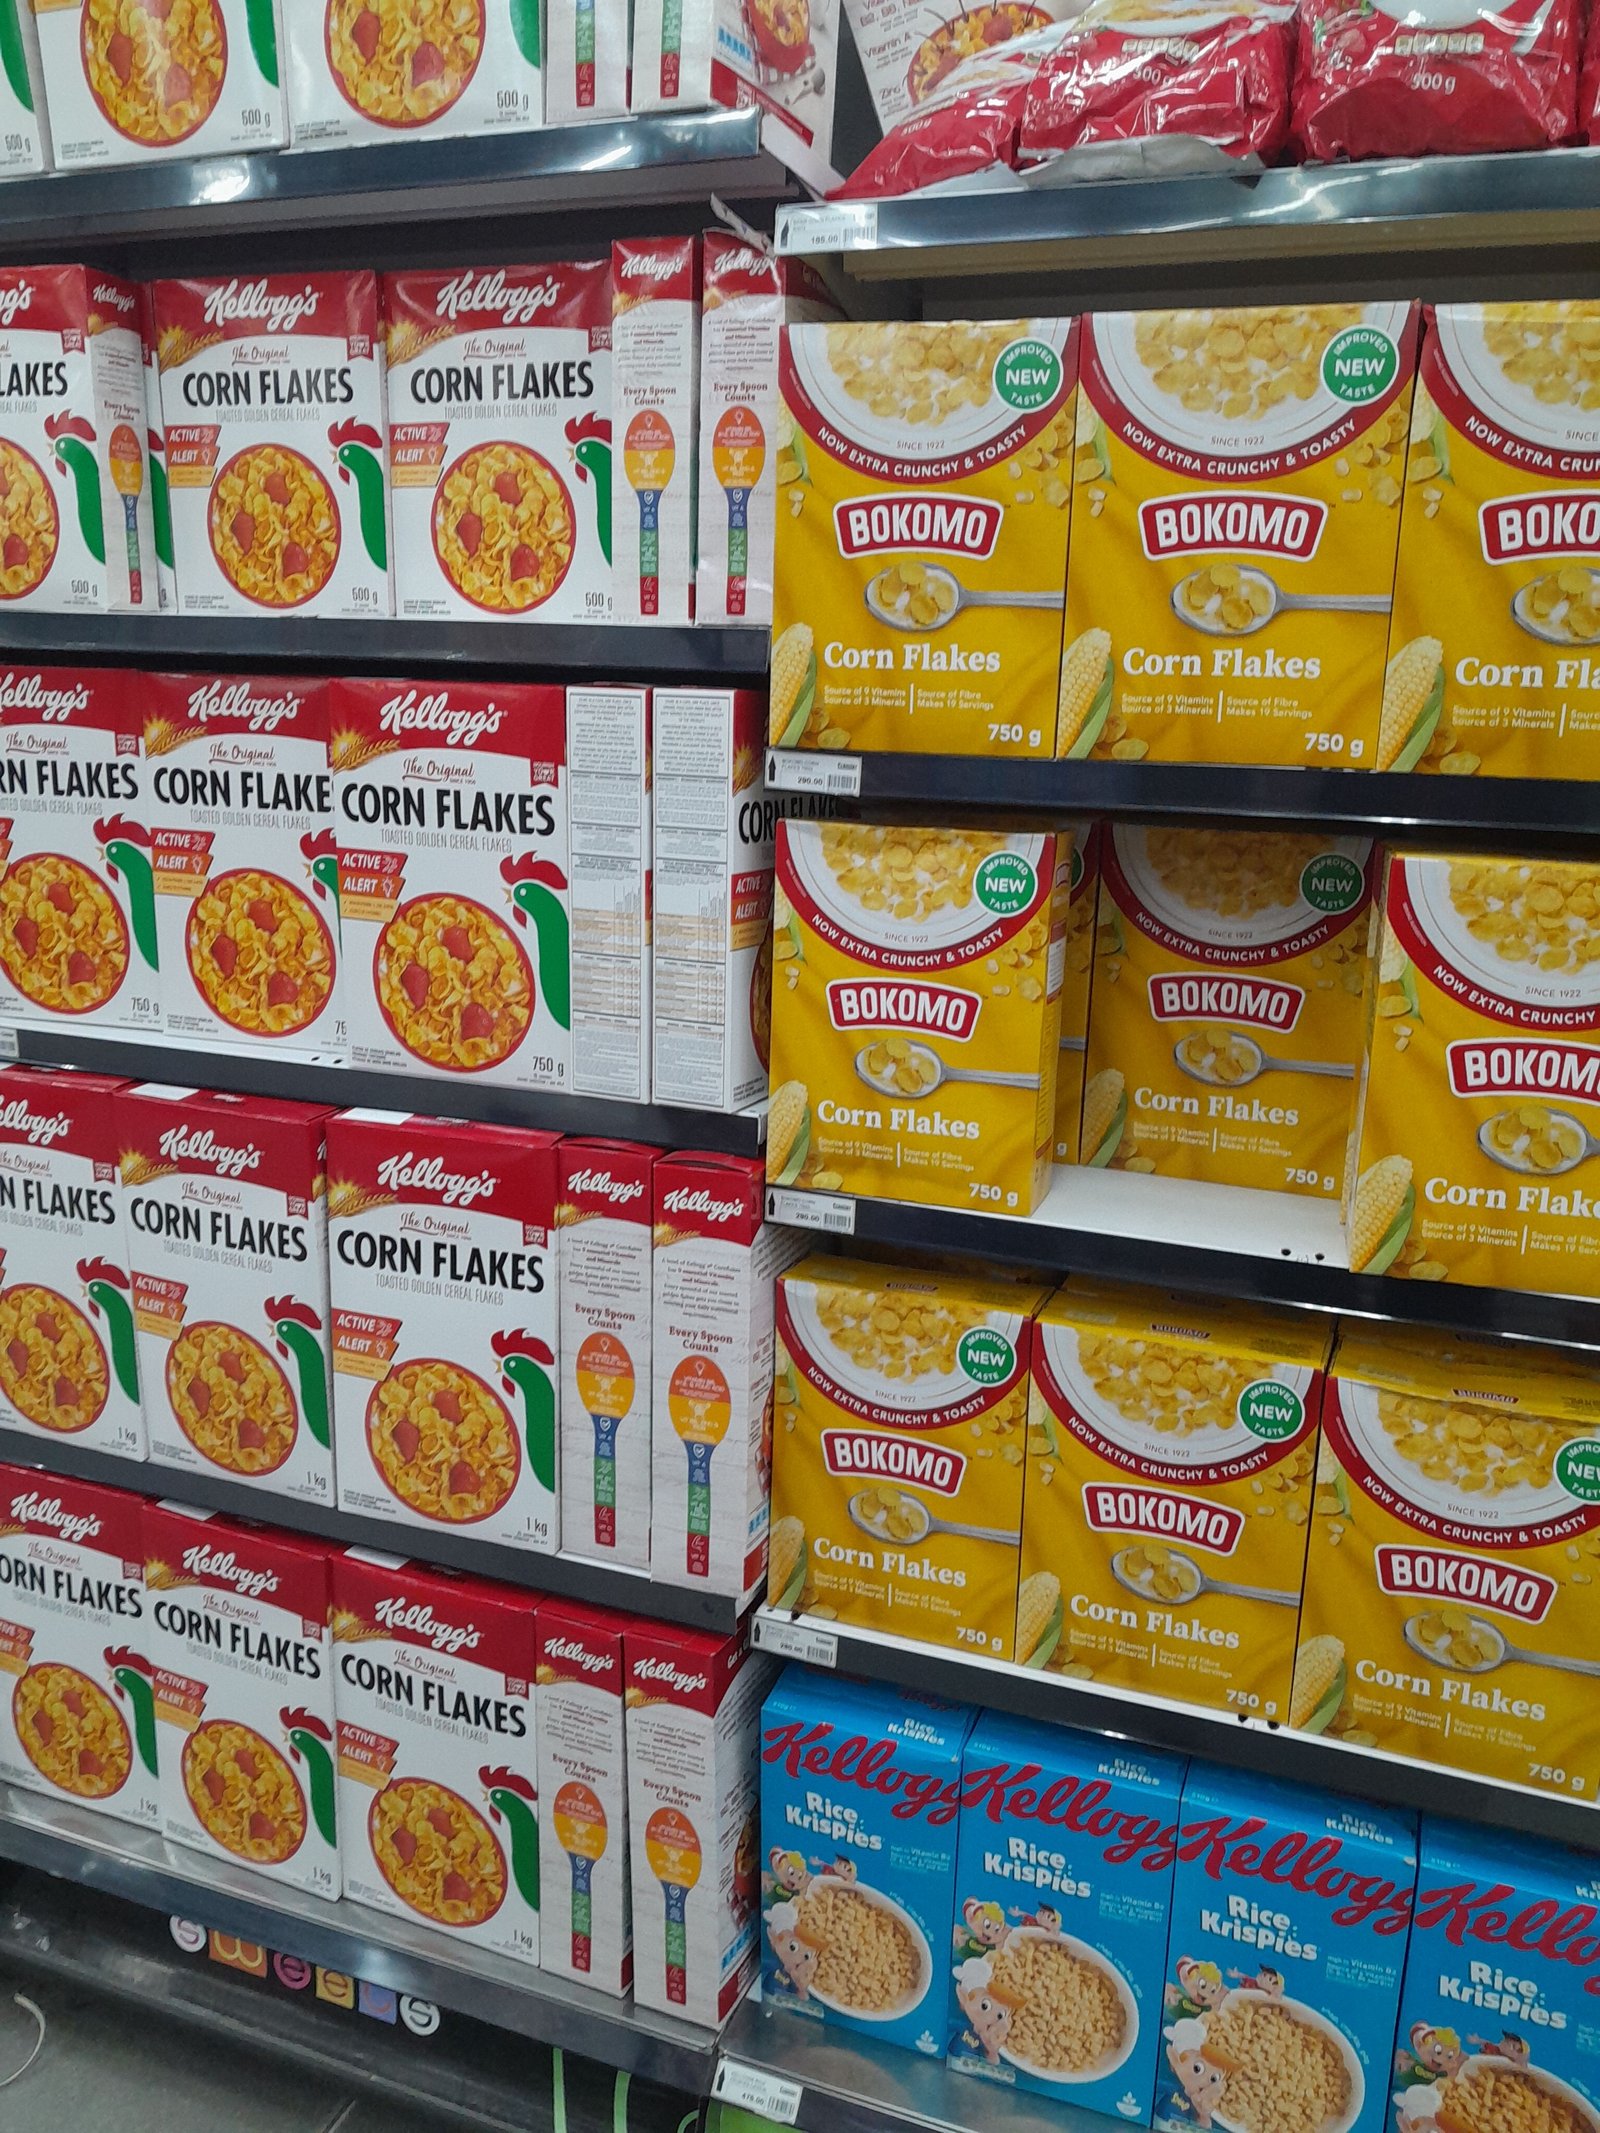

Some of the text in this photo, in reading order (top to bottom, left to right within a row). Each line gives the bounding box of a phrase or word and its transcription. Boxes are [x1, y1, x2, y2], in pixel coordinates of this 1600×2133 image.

[522, 93, 529, 111] g
[620, 254, 684, 281] Kellogg's
[203, 278, 319, 333] Kellogg's
[436, 269, 560, 325] Kellogg's
[1332, 331, 1389, 356] IMPROVED
[410, 360, 595, 404] CORN FLAKES
[1005, 368, 1051, 386] NEW
[1334, 357, 1387, 377] NEW
[182, 367, 354, 407] CORN FLAKES
[1338, 383, 1376, 397] TASTE
[1122, 418, 1357, 476] NOW EXTRA CRUNCHY & TOASTY
[1210, 435, 1265, 448] SINCE 1922
[848, 502, 988, 548] BOKOMO
[1154, 501, 1310, 550] BOKOMO
[823, 641, 1001, 673] Corn Flakes
[1122, 646, 1321, 680] Corn Flakes
[1454, 656, 1544, 689] Corn
[187, 679, 301, 732] Kellogg's
[1153, 704, 1164, 714] of
[1154, 693, 1165, 704] of
[1260, 697, 1272, 707] of
[379, 689, 502, 746] Kellogg's
[1303, 733, 1364, 758] 750 g
[36, 759, 139, 800] FLAKES
[402, 756, 476, 782] The Original
[153, 767, 335, 814] CORN FLAKE
[341, 783, 426, 828] CORN
[436, 789, 556, 837] FLAKES
[381, 829, 512, 854] TOASTED GOLDEN CEREAL FLAKES
[341, 852, 382, 870] ACTIVE
[983, 857, 1029, 876] IMPROVED
[343, 876, 378, 893] ALERT
[984, 876, 1027, 894] NEW
[1310, 877, 1353, 893] NEW
[988, 898, 1019, 912] TASTE
[811, 913, 1004, 967] NOW EXTRA CRUNCHY & TOASTY
[838, 986, 968, 1032] BOKOMO
[1160, 980, 1290, 1024] BOKOMO
[1432, 964, 1597, 1026] NOW EXTRA CRUNCHY
[1524, 985, 1582, 998] SINCE 1922
[531, 1055, 565, 1078] 750 g
[817, 1099, 981, 1140] Corn Flakes
[1133, 1087, 1300, 1127] Corn Flakes
[159, 1124, 263, 1178] Kellogg's
[377, 1151, 498, 1207] Kellogg's
[567, 1168, 645, 1204] Kellogg's
[969, 1182, 1019, 1208] 750 g
[1424, 1176, 1507, 1210] Corn
[22, 1177, 116, 1225] FLAKES
[662, 1186, 745, 1223] Kellogg's
[130, 1196, 308, 1263] CORN FLAKES
[399, 1210, 472, 1237] The Original
[336, 1229, 423, 1276] CORN
[432, 1241, 546, 1294] FLAKES
[336, 1313, 377, 1332] ACTIVE
[668, 1325, 734, 1345] Every Spoon
[337, 1334, 372, 1353] ALERT
[682, 1338, 719, 1354] Counts
[966, 1348, 1007, 1367] NEW
[1247, 1383, 1296, 1406] IMPROVED
[1249, 1402, 1294, 1422] NEW
[1253, 1422, 1286, 1436] TASTE
[833, 1436, 954, 1487] BOKOMO
[10, 1491, 102, 1543] Kellogg's
[534, 1518, 548, 1536] kg
[1096, 1490, 1230, 1547] BOKOMO
[1362, 1474, 1588, 1545] NOW EXTRA CRUNCHY & TOASTY
[1447, 1502, 1500, 1520] SINCE 1922
[182, 1543, 280, 1597] Kellogg's
[812, 1537, 967, 1588] Corn Flakes
[53, 1568, 143, 1619] FLAKES
[1390, 1552, 1541, 1615] BOKOMO
[153, 1600, 322, 1680] CORN FLAKES
[374, 1596, 484, 1653] Kellogg's
[1069, 1593, 1241, 1650] Corn Flakes
[544, 1636, 616, 1673] Kellogg's
[632, 1656, 708, 1693] Kellogg's
[1354, 1658, 1547, 1722] Corn Flakes
[340, 1653, 414, 1707] CORN
[422, 1679, 528, 1738] FLAKES
[1528, 1762, 1586, 1792] 750 g
[806, 1790, 859, 1824] Rice
[785, 1804, 884, 1851] Krispies
[1008, 1836, 1067, 1870] Rice
[984, 1851, 1092, 1898] Krispies
[1228, 1893, 1291, 1931] Rice
[520, 1933, 533, 1950] kg
[1201, 1908, 1319, 1961] Krispies
[1470, 1959, 1538, 1998] Rice
[1439, 1974, 1568, 2030] Krispies
